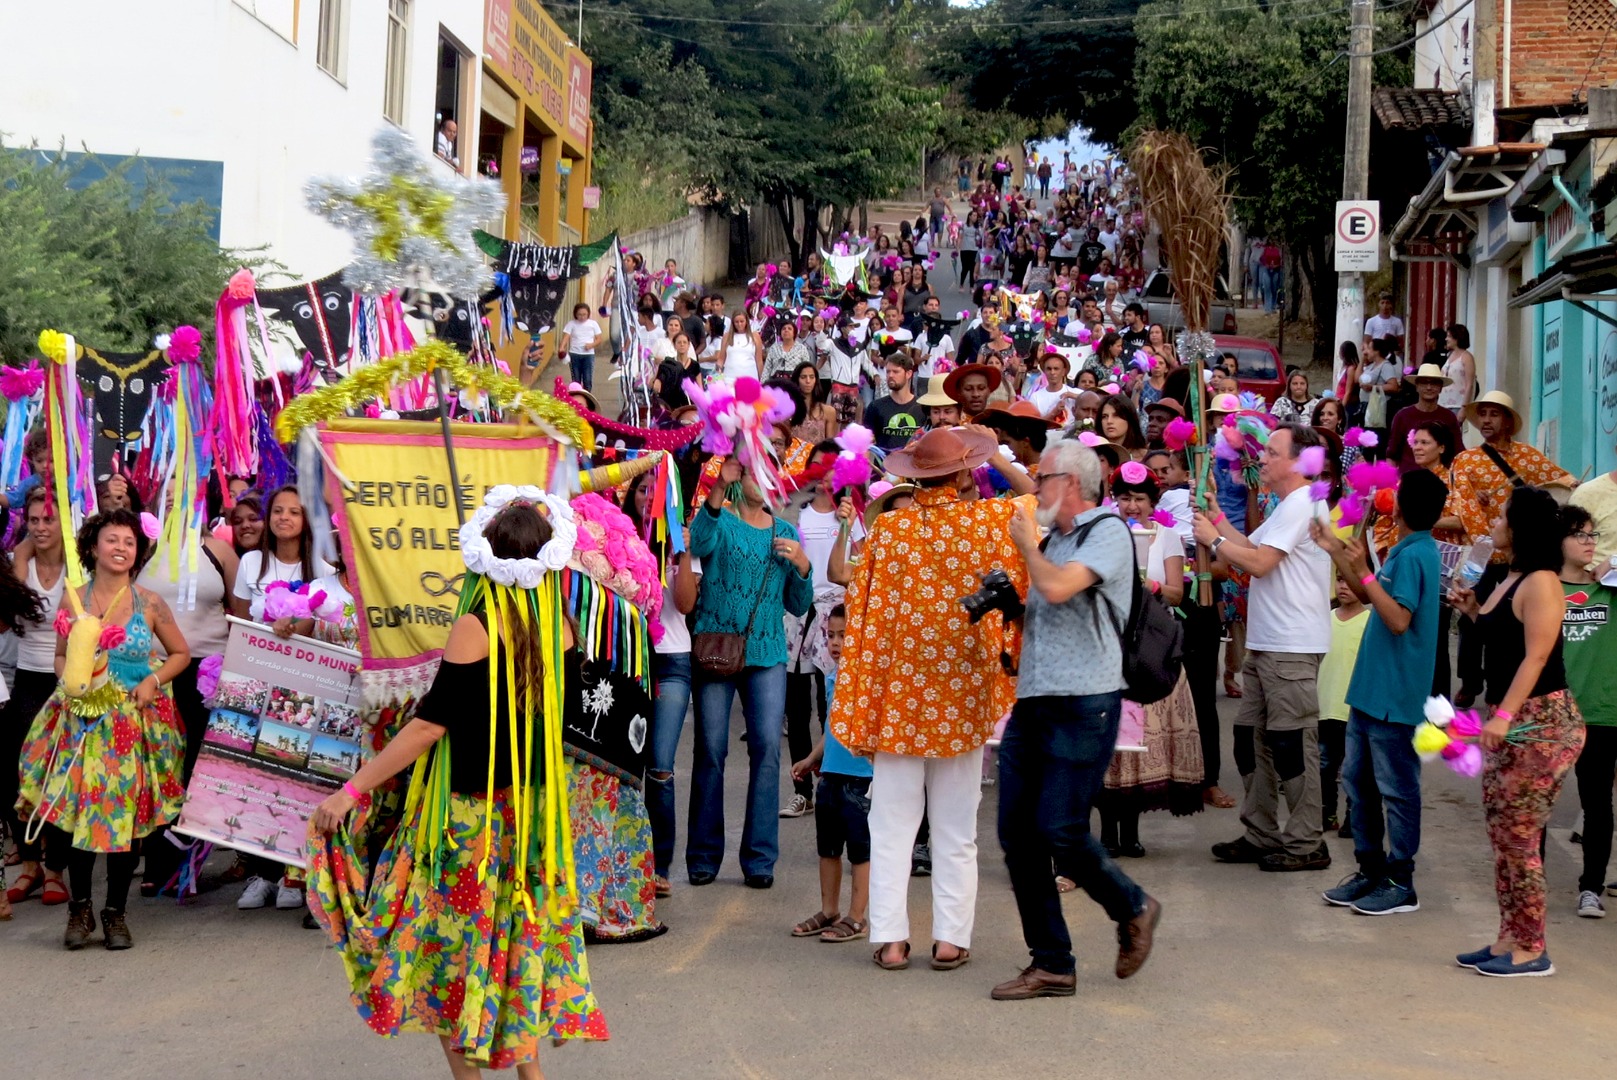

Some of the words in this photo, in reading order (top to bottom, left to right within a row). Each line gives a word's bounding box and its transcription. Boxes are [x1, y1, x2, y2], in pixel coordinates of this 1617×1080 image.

[1350, 216, 1366, 235] E
[369, 518, 403, 550] SÓ
[295, 648, 315, 663] DO
[255, 657, 281, 671] sertão
[316, 674, 335, 686] todo
